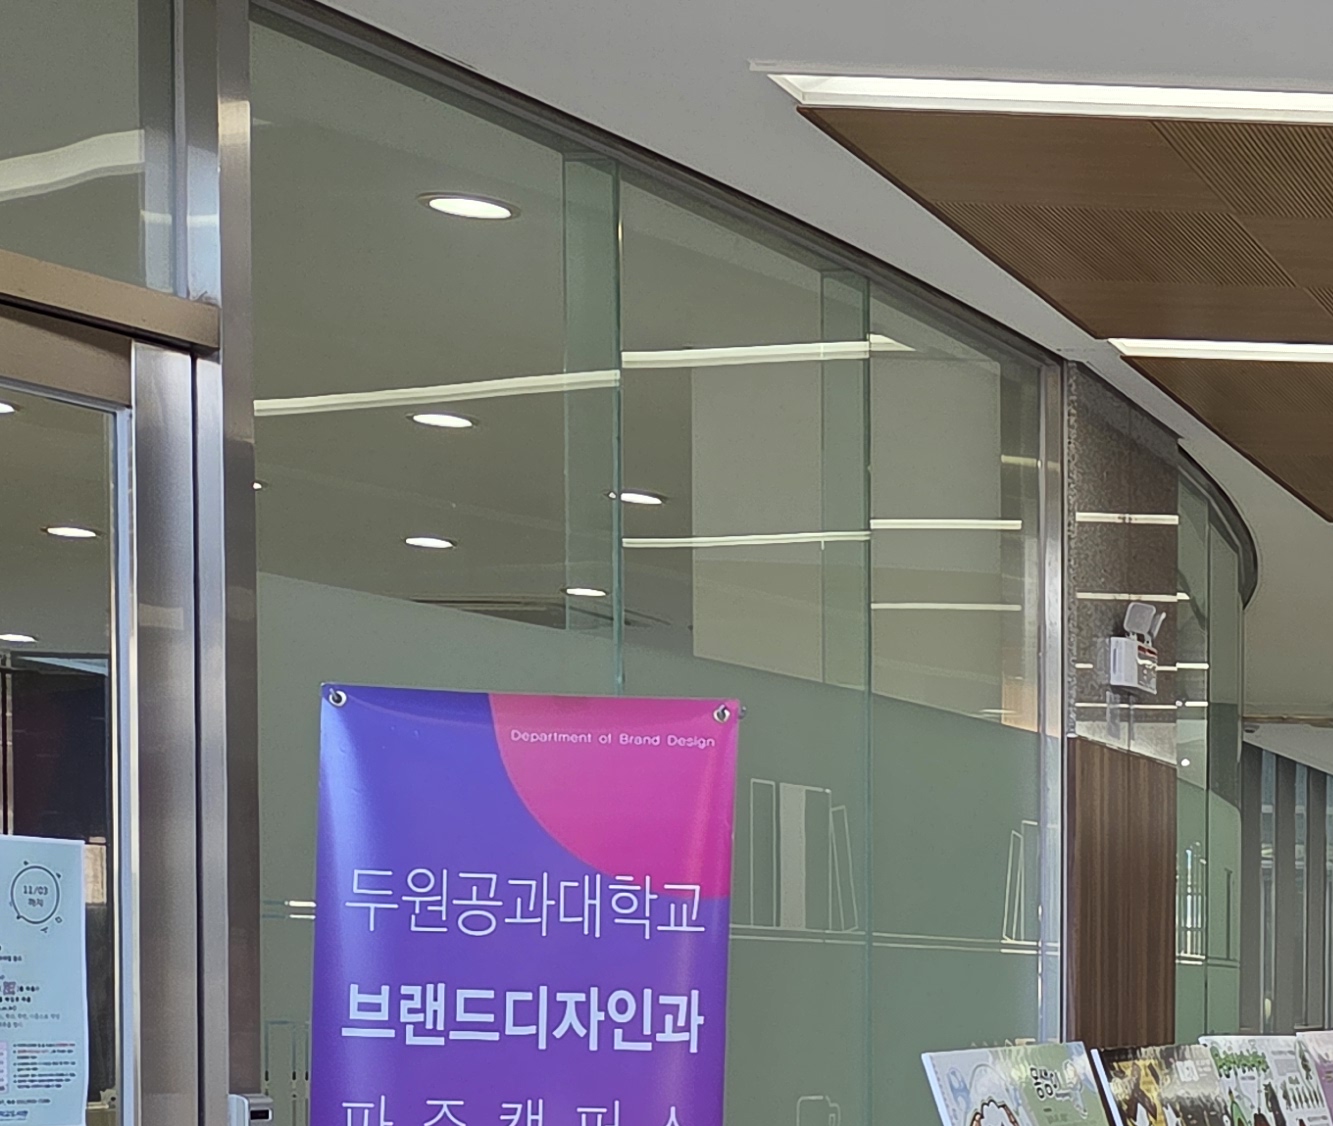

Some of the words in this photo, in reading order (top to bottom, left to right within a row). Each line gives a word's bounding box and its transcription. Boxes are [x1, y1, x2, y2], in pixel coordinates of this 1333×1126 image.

[511, 729, 592, 743] Department
[599, 733, 612, 744] of
[619, 733, 660, 745] Brand
[667, 734, 715, 749] Design
[345, 868, 706, 940] 두원공과대학교
[341, 982, 705, 1053] 브랜드디자인과
